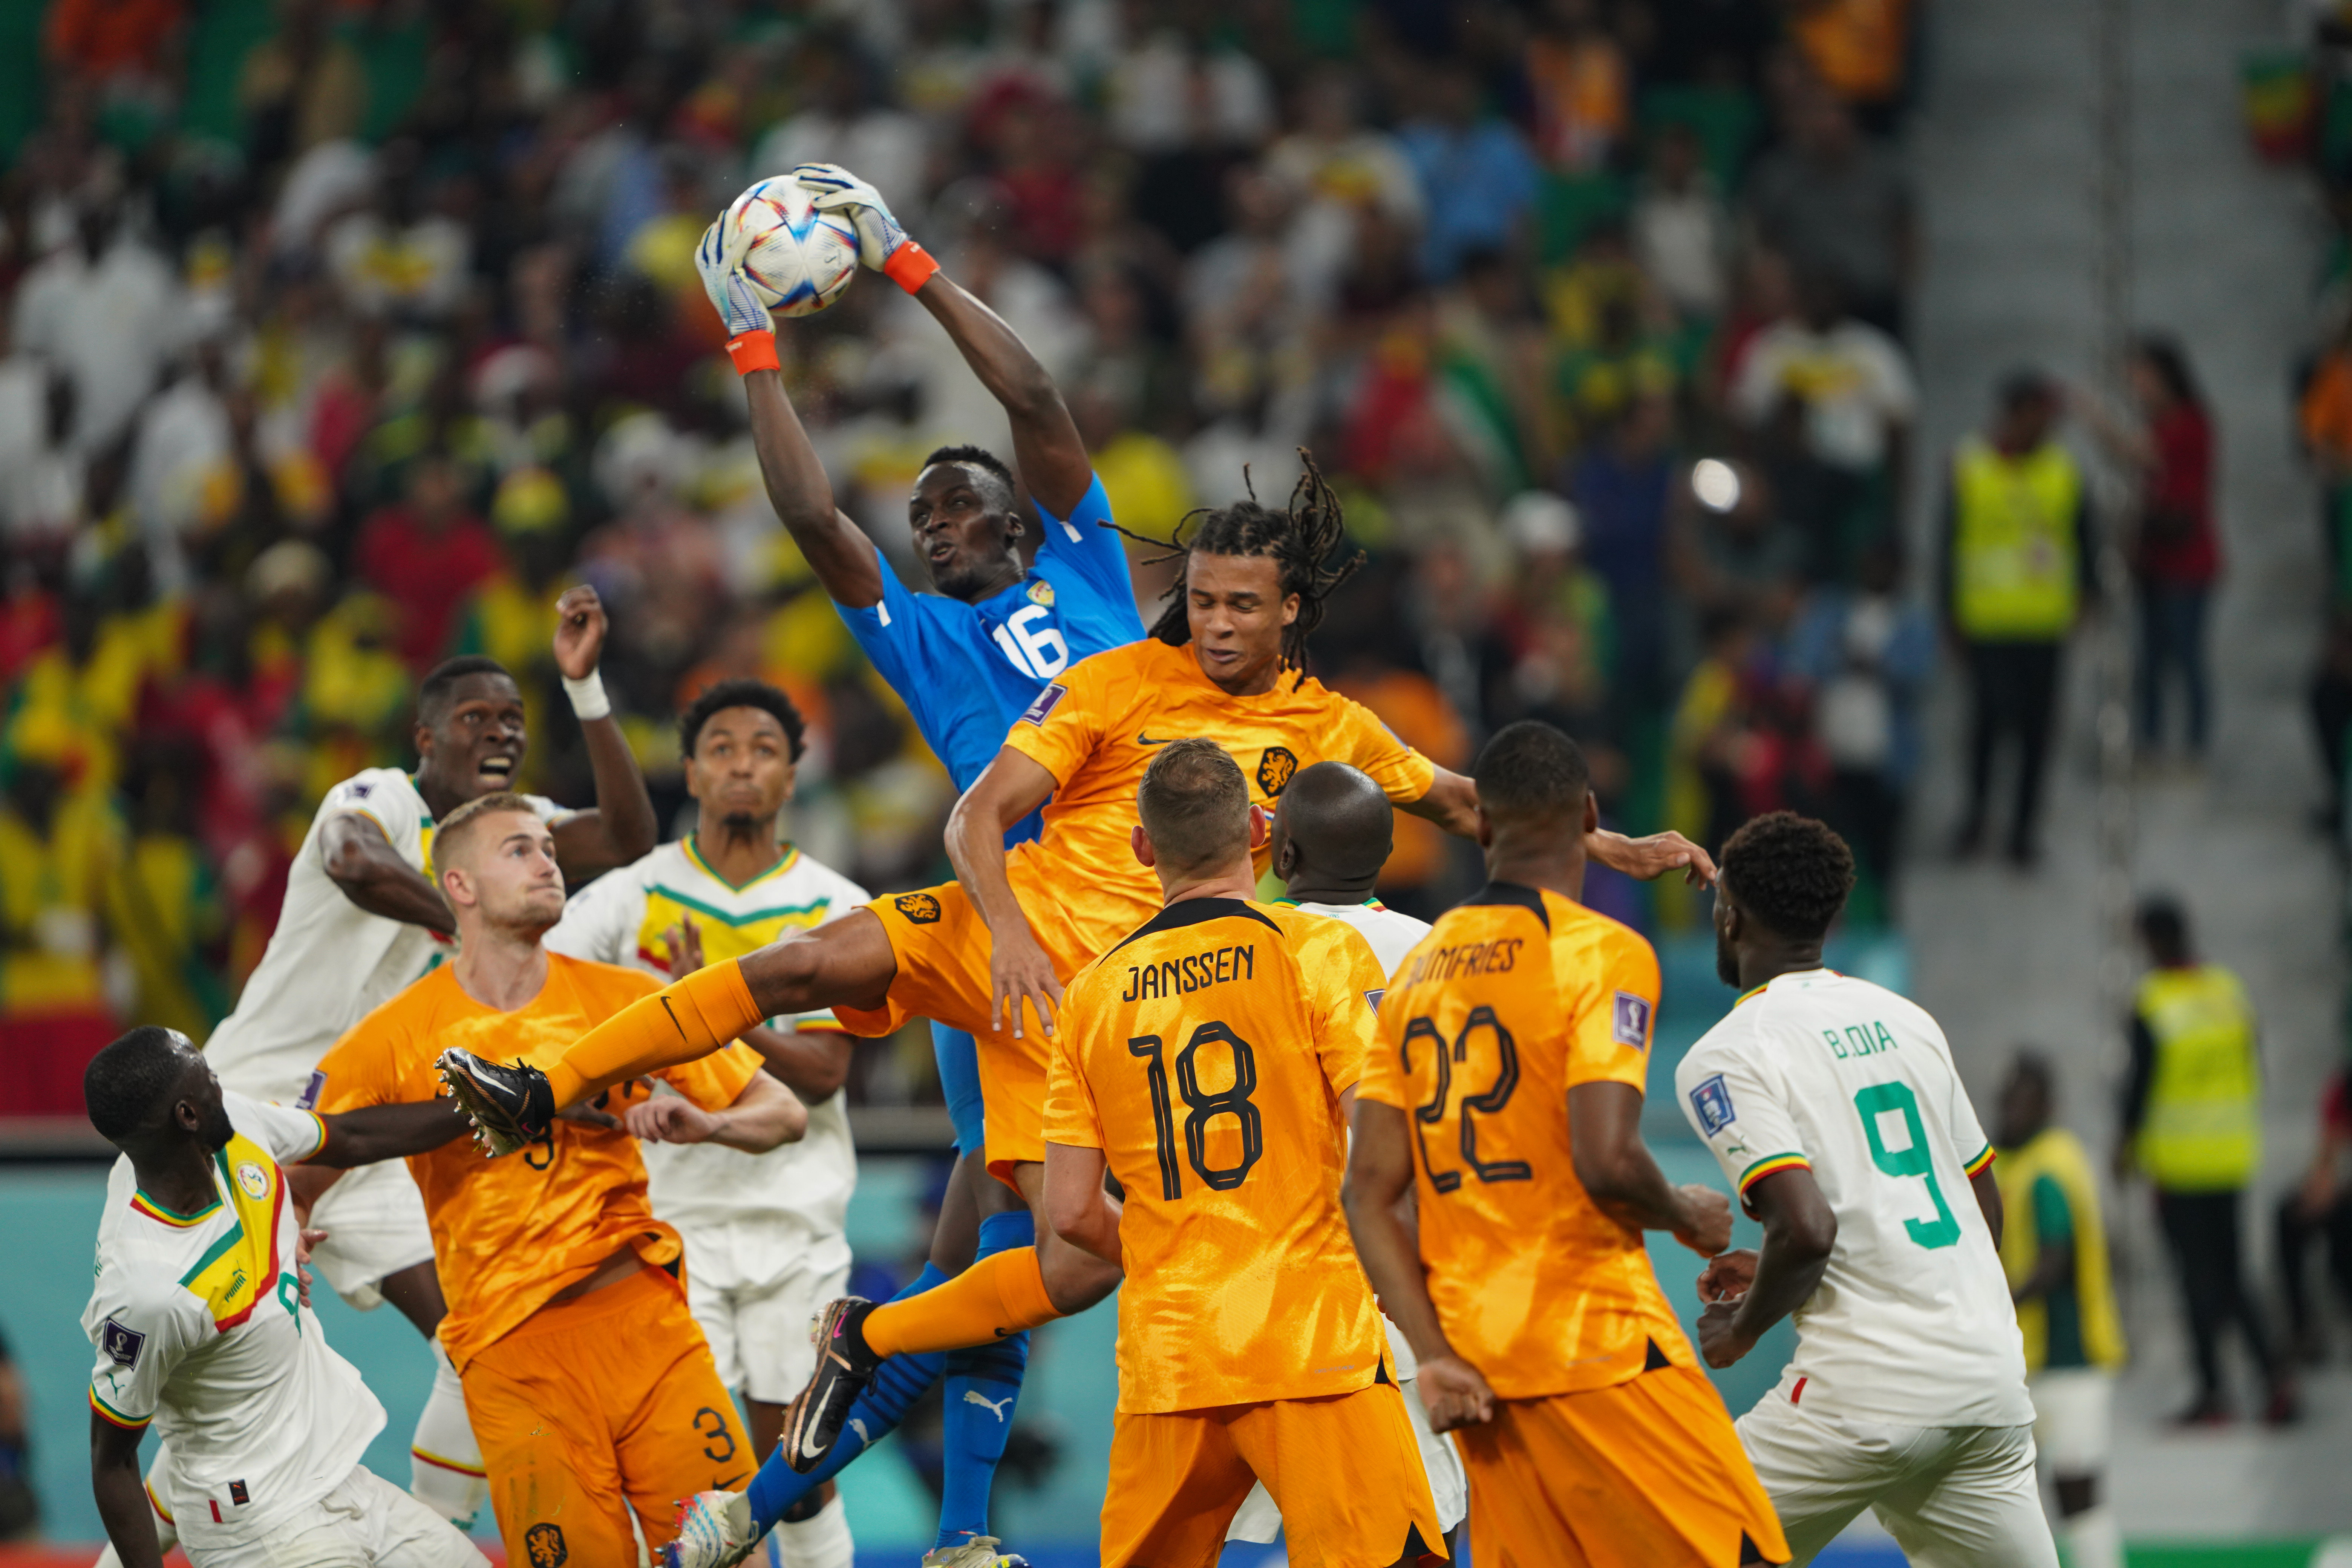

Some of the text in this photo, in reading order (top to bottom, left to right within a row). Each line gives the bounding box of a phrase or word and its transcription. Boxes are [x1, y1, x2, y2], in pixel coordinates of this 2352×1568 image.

[992, 604, 1069, 679] 16
[1122, 945, 1254, 1003] JANSSEN
[1822, 1021, 1898, 1060] B.DIA
[1127, 1020, 1263, 1202] 18
[1400, 1006, 1532, 1195] 22
[1854, 1081, 1961, 1250] 9
[693, 1407, 736, 1463] 3
